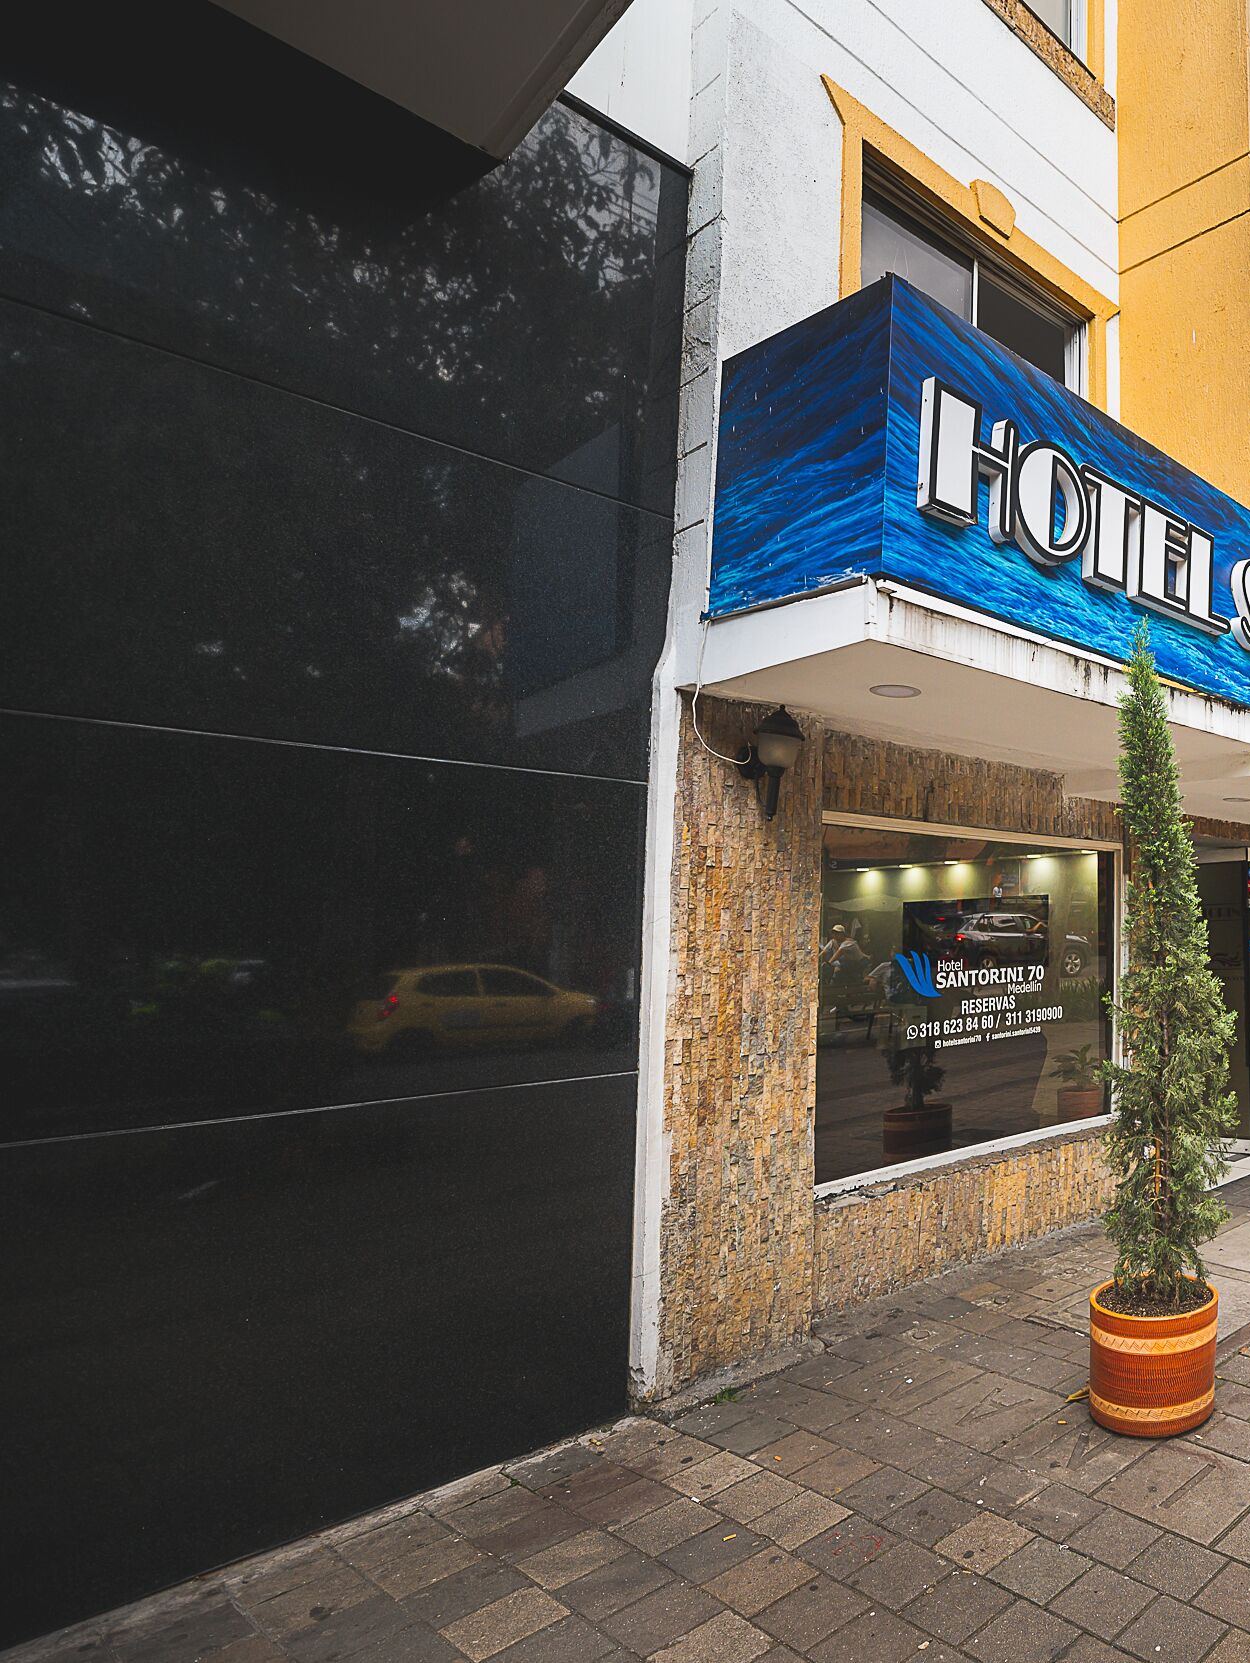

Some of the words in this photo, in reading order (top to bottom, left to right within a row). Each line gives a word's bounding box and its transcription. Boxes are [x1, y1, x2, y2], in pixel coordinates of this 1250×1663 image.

[916, 375, 1232, 638] HOTEL
[937, 959, 963, 972] Hotel
[935, 966, 1024, 989] SANTORINI
[1027, 965, 1045, 982] 70
[1007, 980, 1042, 995] Medellín
[961, 995, 1016, 1015] RESERVAS
[919, 1021, 941, 1038] 318
[943, 1019, 963, 1035] 623
[966, 1017, 979, 1032] 84
[981, 1014, 994, 1030] 60
[1005, 1010, 1022, 1026] 311
[1025, 1006, 1063, 1023] 3190900
